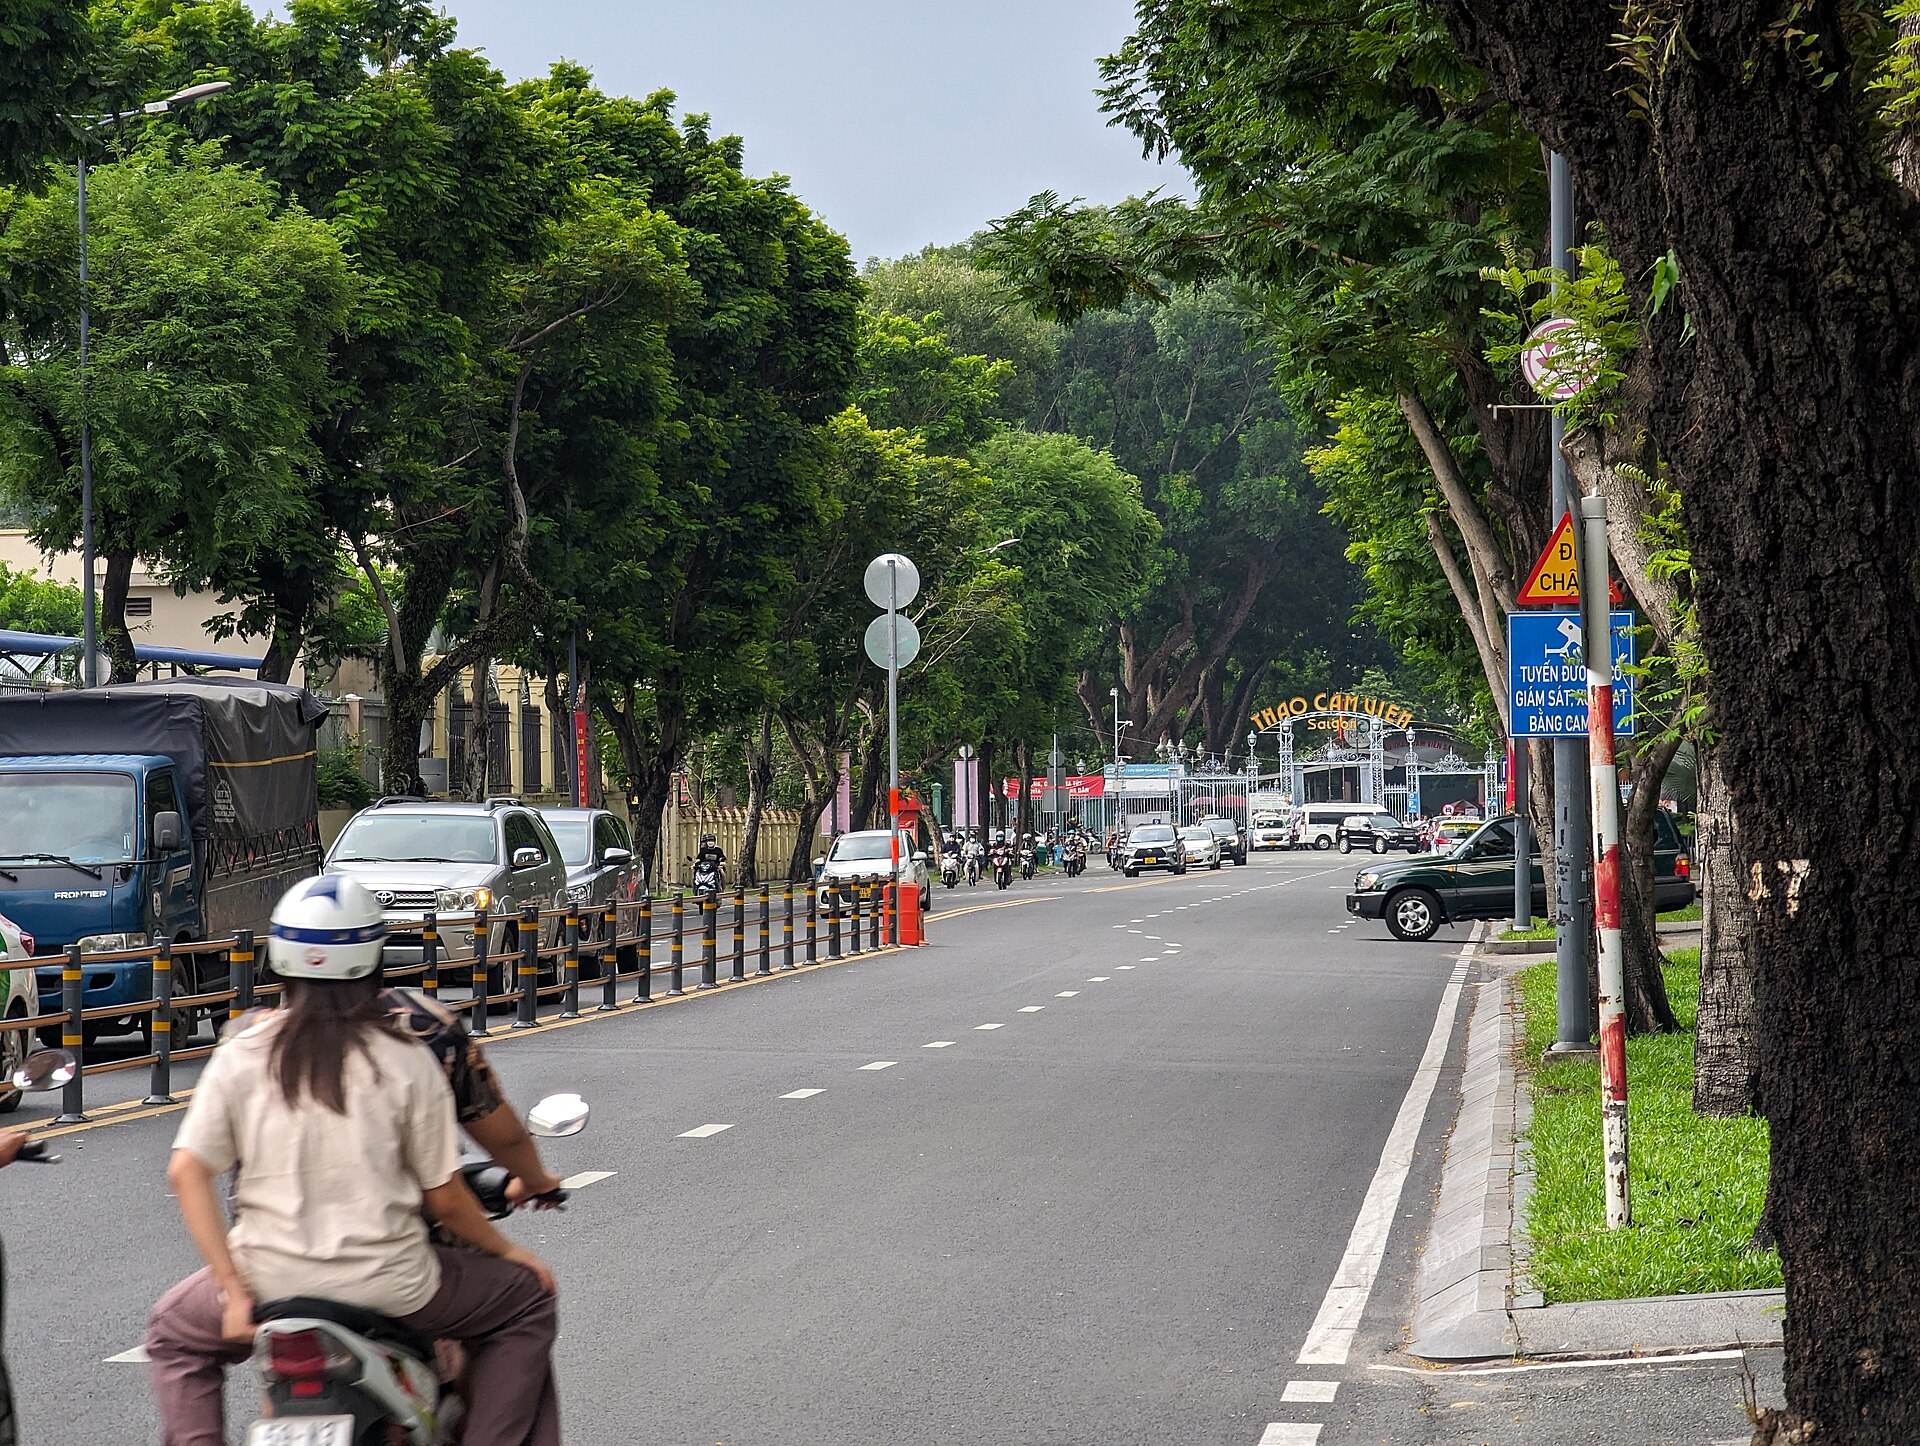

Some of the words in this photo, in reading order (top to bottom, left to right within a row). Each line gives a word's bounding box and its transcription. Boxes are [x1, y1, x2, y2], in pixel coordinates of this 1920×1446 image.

[1540, 568, 1579, 594] CHẬ
[1520, 659, 1558, 682] TUYẾN
[1515, 685, 1545, 707] GIÁM
[1548, 685, 1573, 707] SÁT,
[1612, 689, 1628, 710] ẠT
[1307, 718, 1357, 731] Saigon
[1529, 708, 1562, 732] BẰNG
[1566, 715, 1589, 732] CAM
[54, 890, 108, 899] FRONTIER
